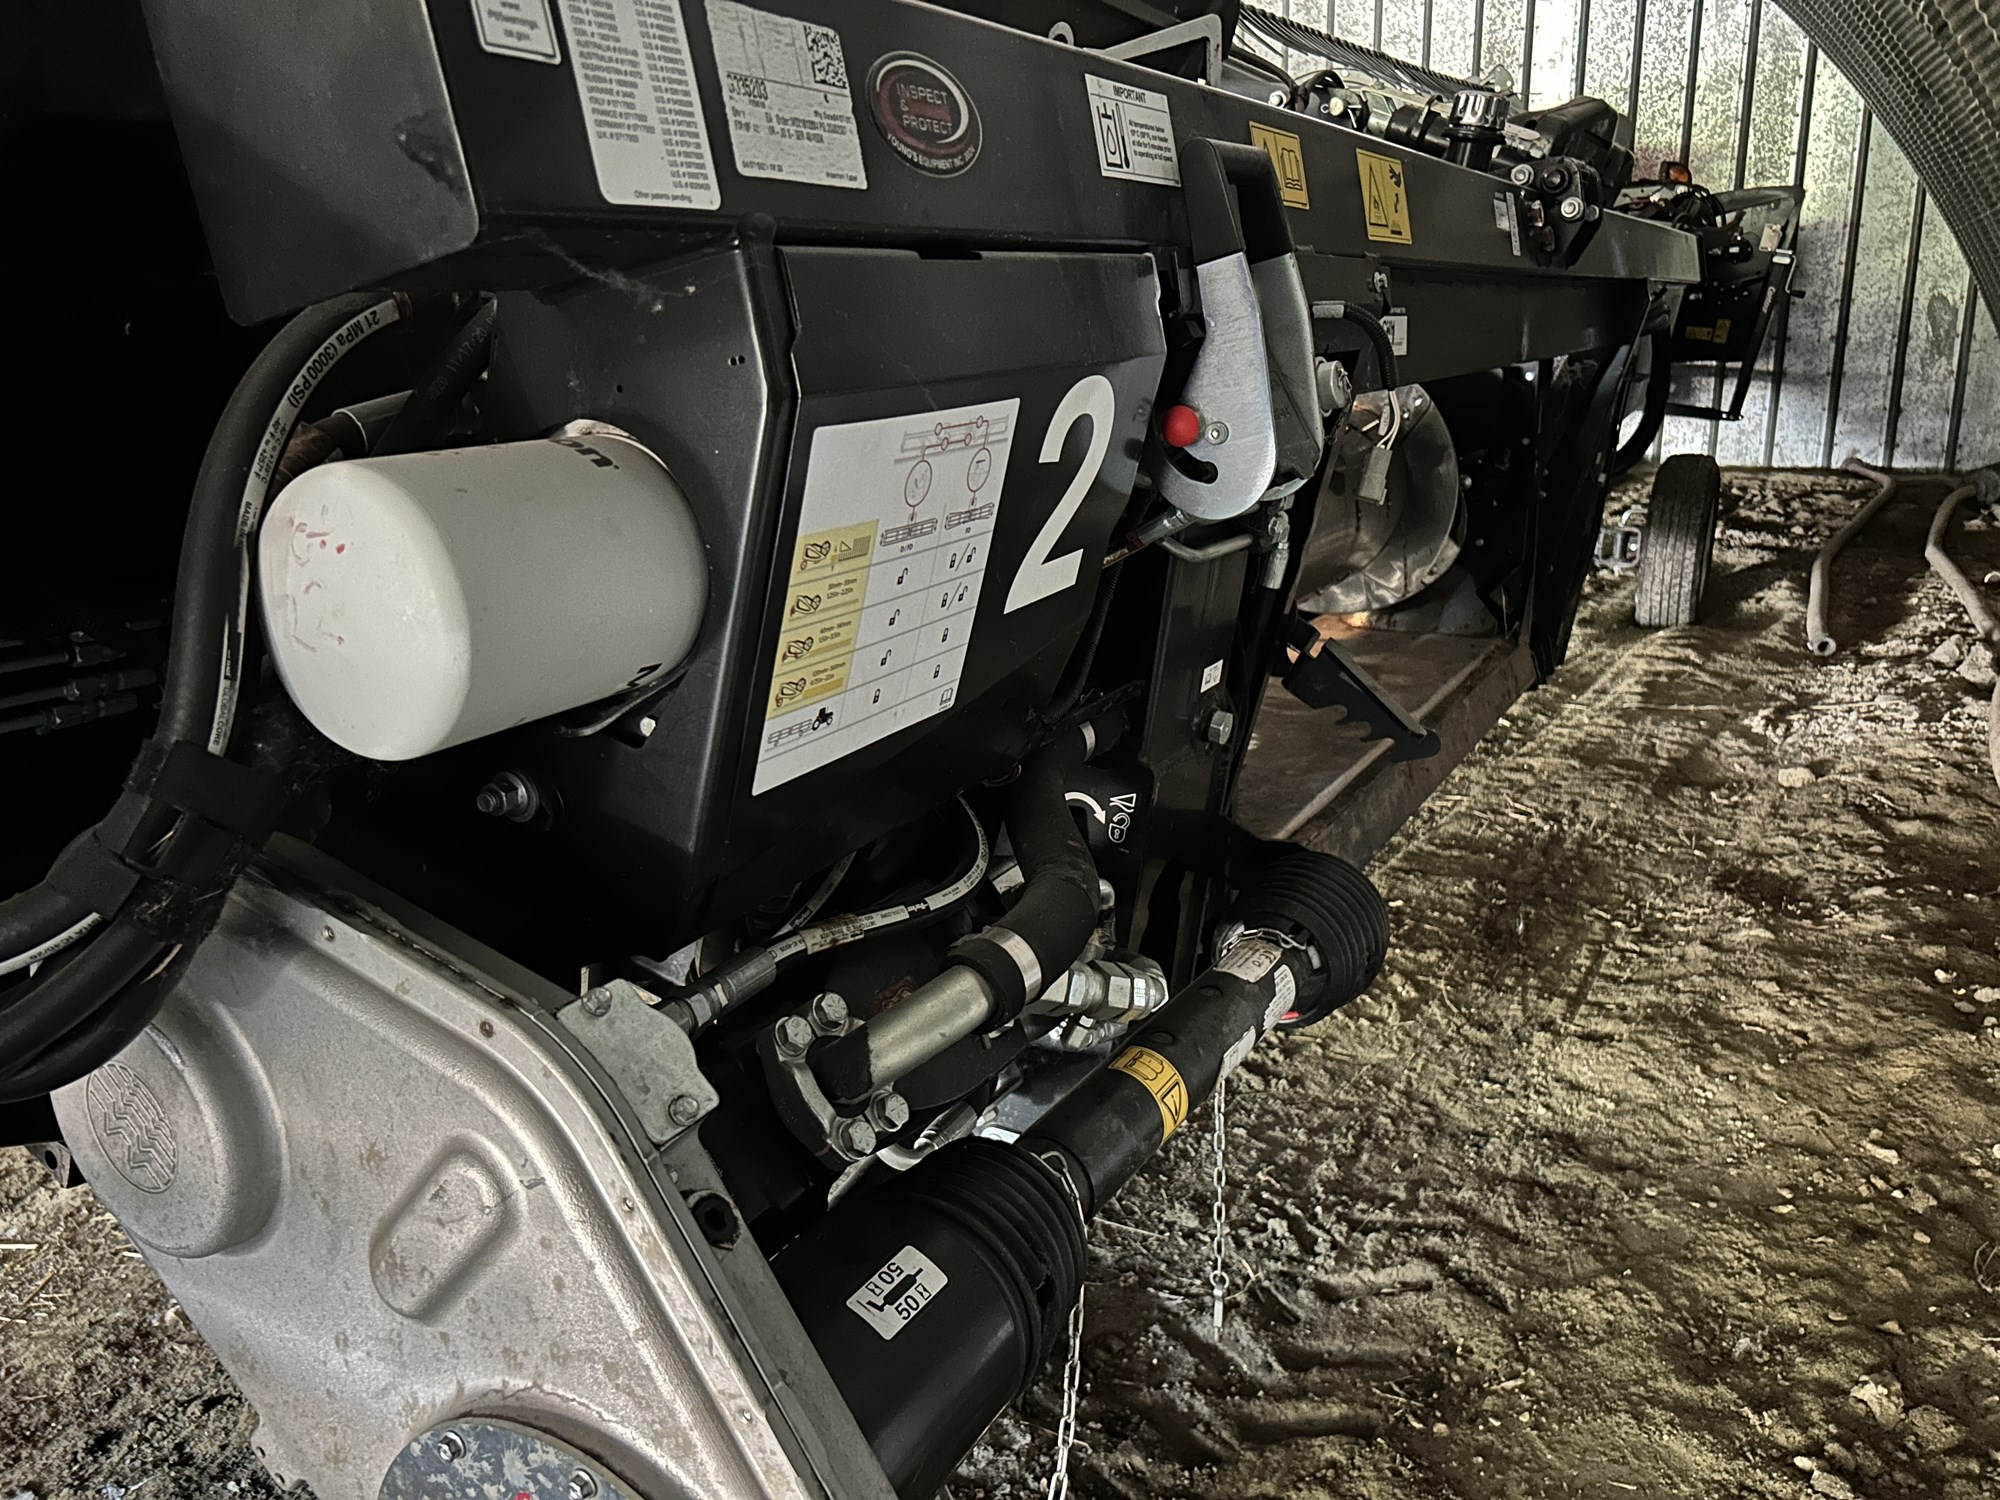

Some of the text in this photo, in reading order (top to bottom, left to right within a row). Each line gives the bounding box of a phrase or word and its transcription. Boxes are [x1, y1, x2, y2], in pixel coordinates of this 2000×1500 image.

[896, 82, 947, 104] INSPECT
[1113, 85, 1146, 103] IMPORTANT
[899, 99, 909, 111] &
[902, 115, 952, 134] PROTECT
[887, 133, 918, 162] YOUNG'S
[918, 155, 953, 169] EQUIPMENT
[287, 309, 380, 409] 21 MPa (3000 PSI)
[268, 431, 276, 440] F
[254, 471, 261, 480] F
[1004, 375, 1115, 614] 2
[240, 501, 253, 527] MADE
[878, 1262, 904, 1285] 50
[895, 1295, 920, 1321] 50
